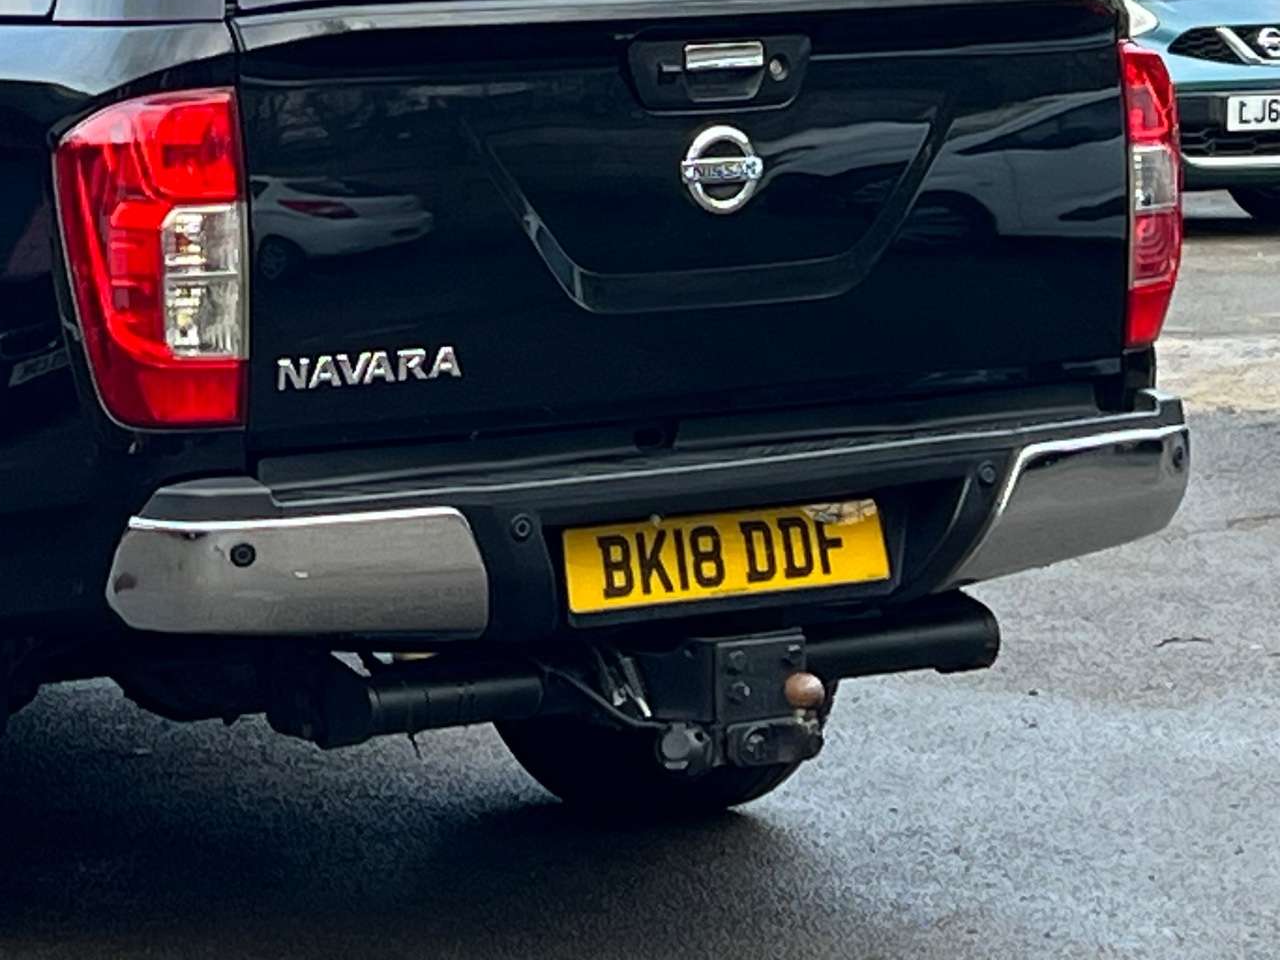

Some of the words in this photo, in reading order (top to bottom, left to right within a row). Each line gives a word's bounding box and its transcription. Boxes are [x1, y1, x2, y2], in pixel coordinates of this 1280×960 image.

[276, 345, 462, 391] NAVARA
[595, 524, 726, 600] BK18
[738, 515, 844, 583] DDF
